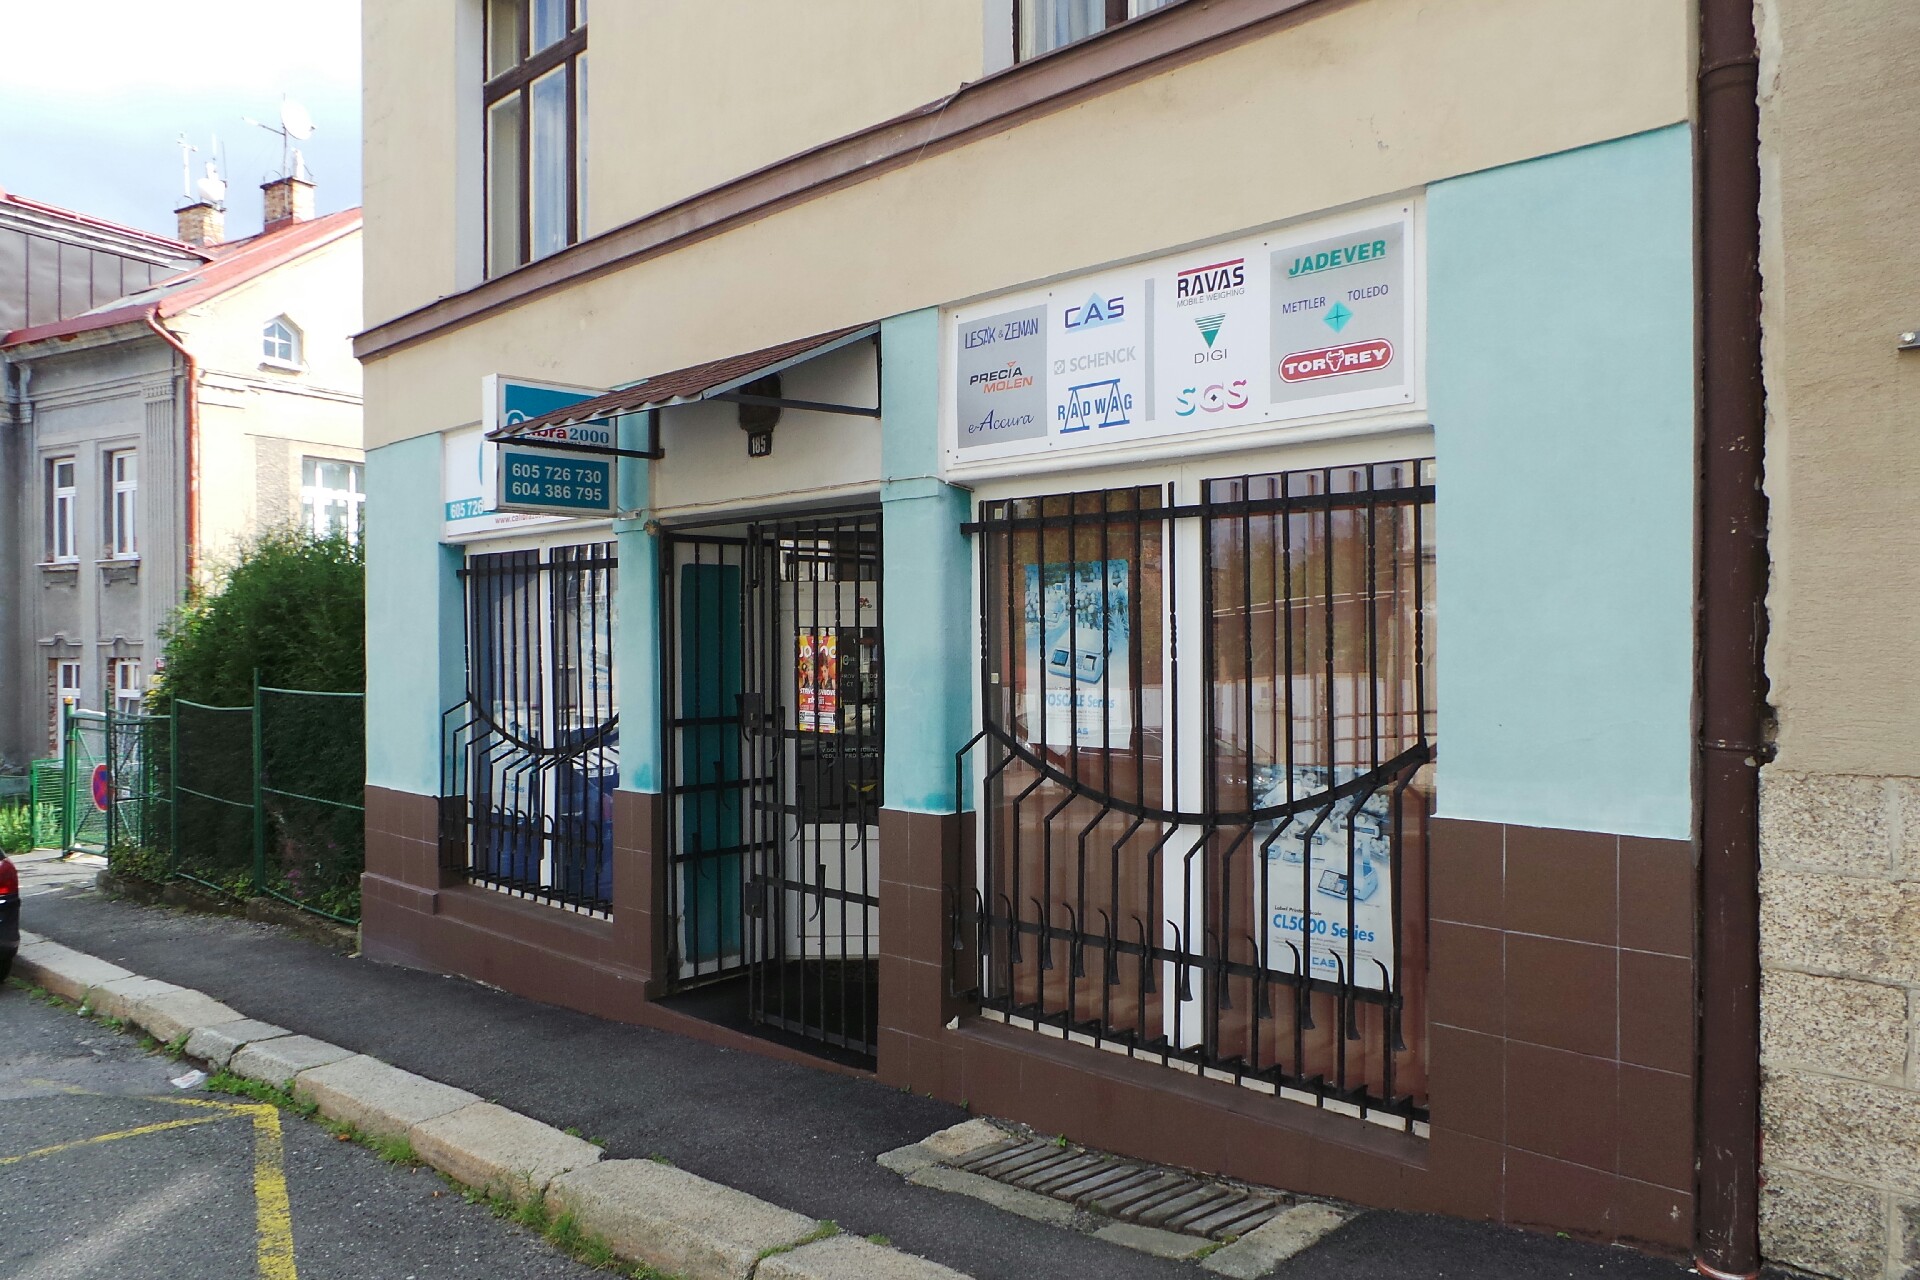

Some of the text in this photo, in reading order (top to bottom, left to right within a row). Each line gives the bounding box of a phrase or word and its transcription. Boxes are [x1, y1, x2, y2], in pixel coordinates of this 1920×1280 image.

[1288, 240, 1386, 276] JADEVER
[1177, 265, 1245, 299] RAVAS
[1176, 287, 1245, 309] MOBILE WEIGHING
[1282, 284, 1389, 314] METTLER TOLEDO
[1064, 296, 1125, 329] CAS
[1004, 317, 1039, 341] ZEMAN
[1069, 345, 1137, 373] SCHENCK
[1194, 348, 1228, 364] DIGI
[983, 375, 1033, 394] MOLEN
[1057, 391, 1133, 422] RADWAG
[569, 428, 610, 444] 2000
[751, 434, 767, 455] 185
[512, 463, 602, 484] 605 726 730
[512, 483, 602, 501] 604 386 795
[450, 503, 466, 519] 605
[1330, 922, 1375, 942] Seies
[1311, 957, 1337, 969] CAS
